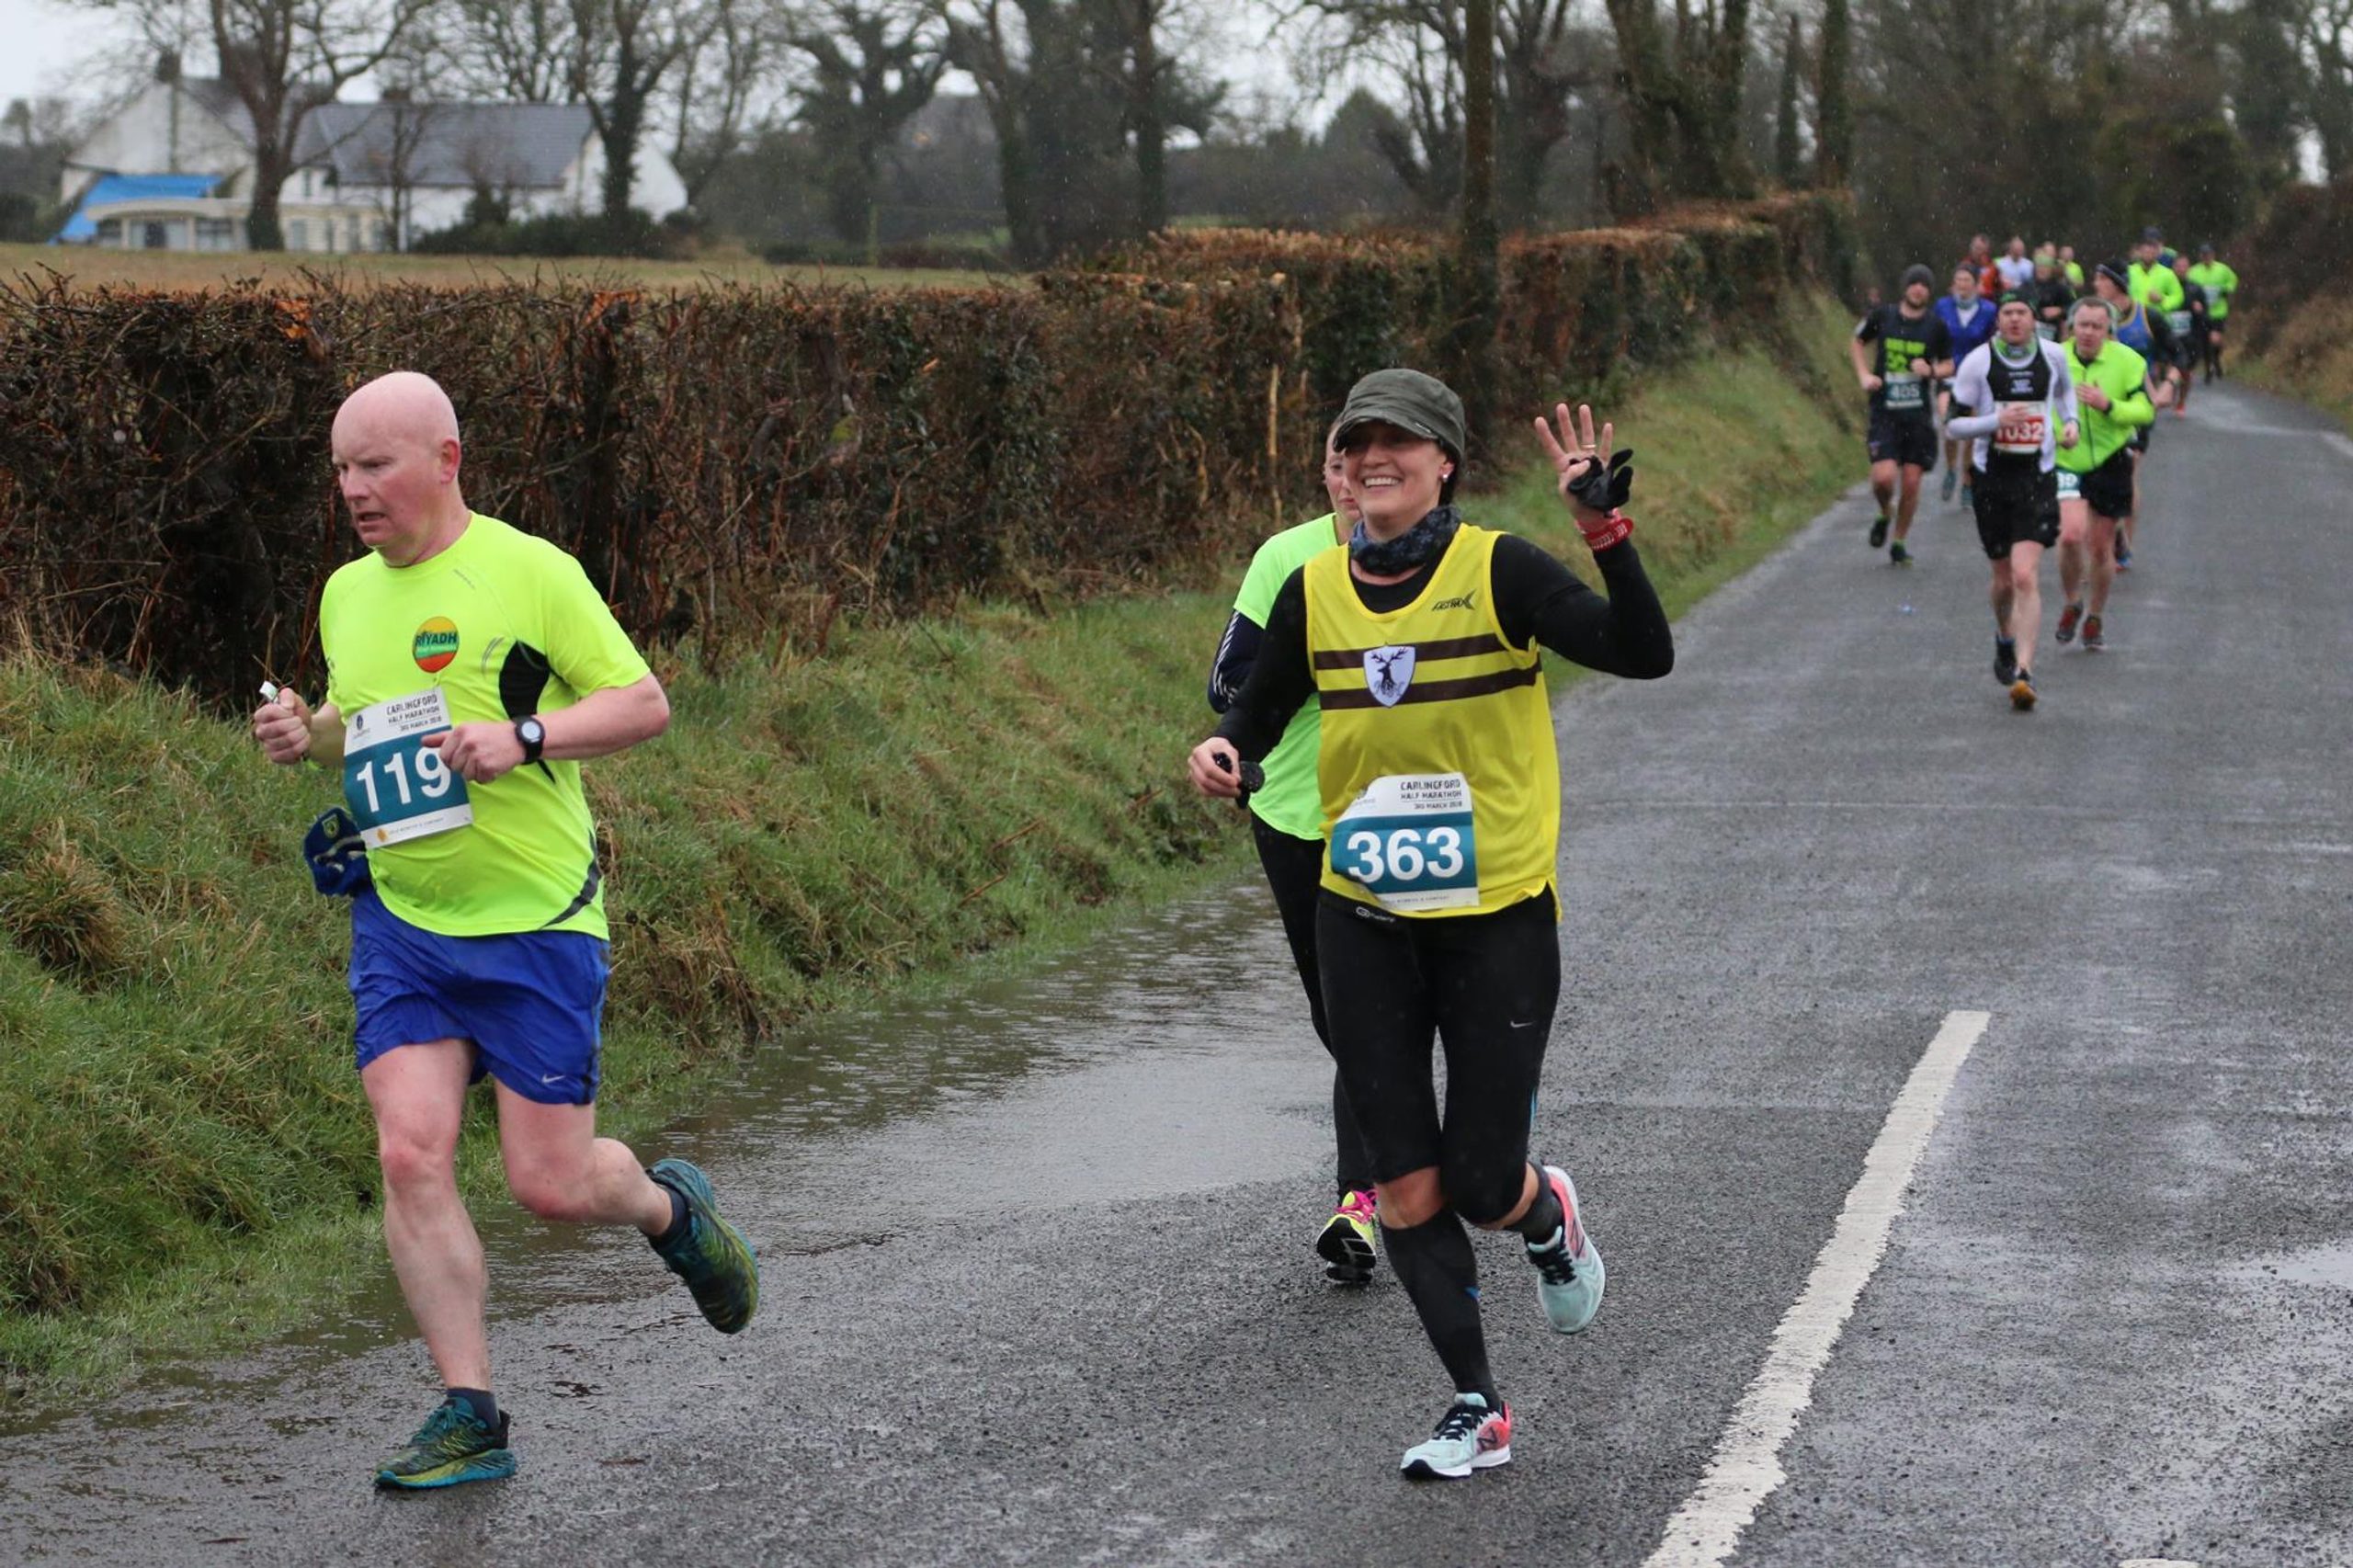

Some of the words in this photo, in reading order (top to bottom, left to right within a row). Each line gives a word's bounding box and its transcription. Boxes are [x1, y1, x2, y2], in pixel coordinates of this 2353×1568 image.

[415, 631, 458, 647] RIYADH
[387, 694, 438, 716] CARLINGFORD
[405, 705, 439, 720] MARATHON
[357, 746, 451, 812] 119
[1400, 778, 1461, 791] CARLINGFORD
[1401, 791, 1419, 800] HALF
[1422, 790, 1461, 799] MARATHON
[1347, 826, 1464, 883] 363
